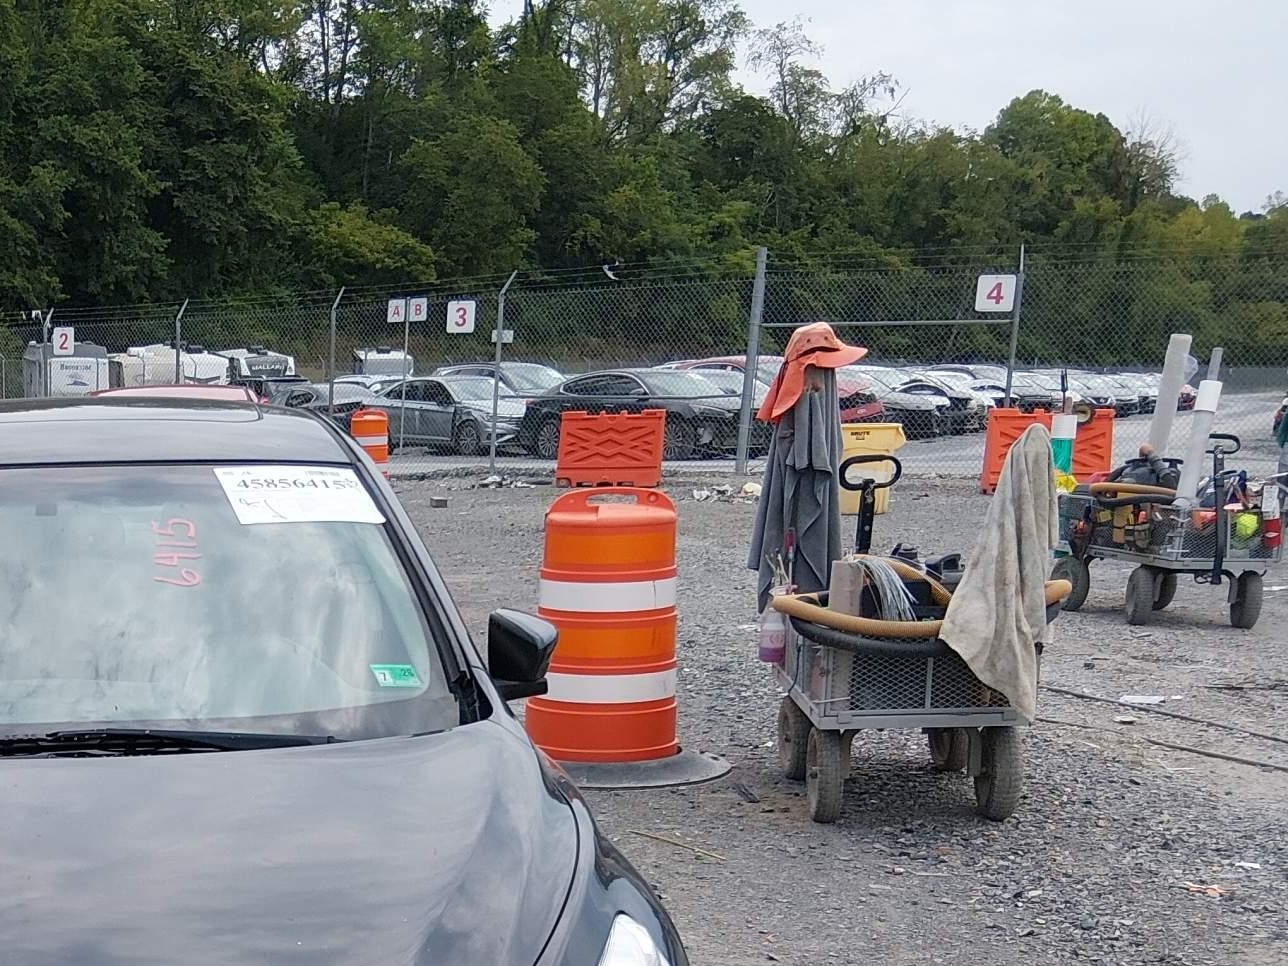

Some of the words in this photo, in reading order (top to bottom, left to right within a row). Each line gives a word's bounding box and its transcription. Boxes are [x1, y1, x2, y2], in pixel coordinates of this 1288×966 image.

[986, 282, 1004, 304] 4
[392, 305, 400, 317] A
[414, 303, 422, 316] B
[455, 307, 467, 327] 3
[59, 333, 69, 350] 2
[236, 478, 345, 490] 45856415
[152, 518, 202, 588] 6415
